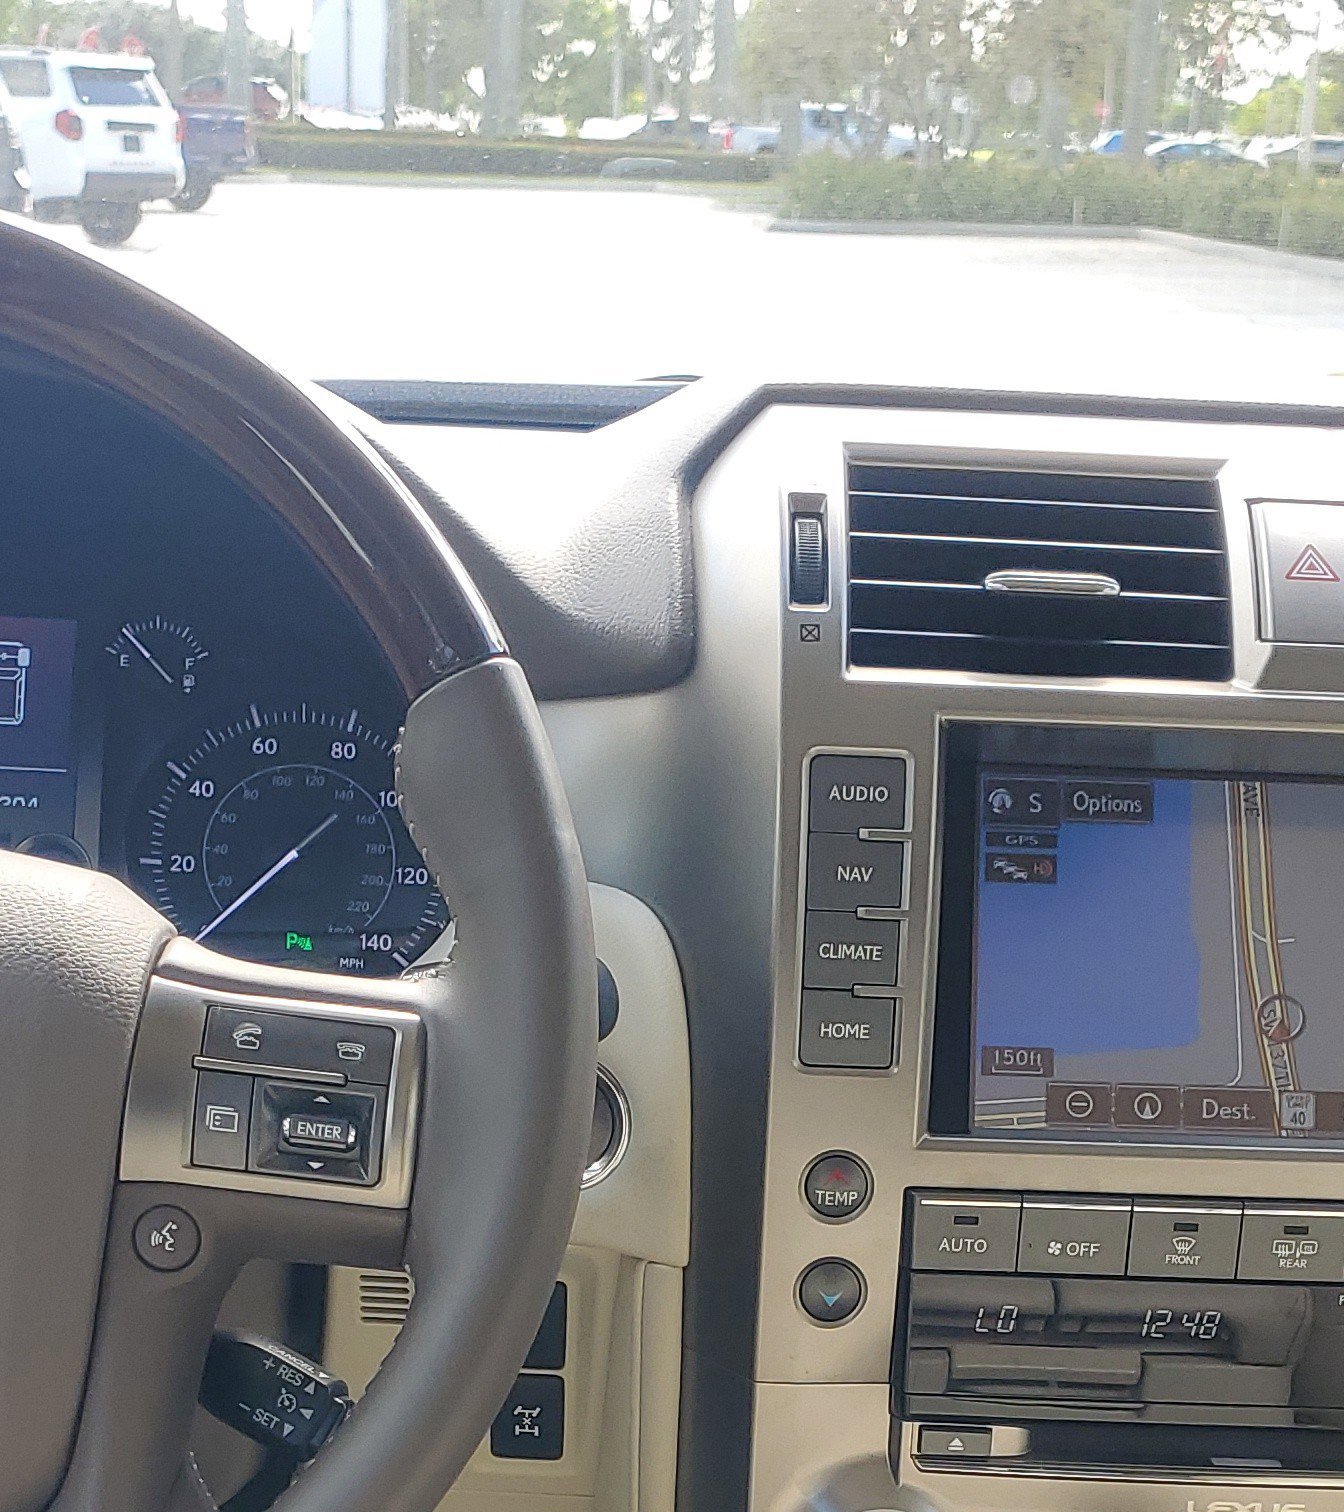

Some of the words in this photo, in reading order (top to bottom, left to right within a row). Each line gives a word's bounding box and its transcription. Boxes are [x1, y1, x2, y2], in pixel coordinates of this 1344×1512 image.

[120, 654, 130, 667] E
[185, 657, 196, 670] F
[252, 738, 278, 755] 60
[330, 742, 356, 760] 80
[188, 780, 214, 798] 40
[828, 784, 889, 803] AUDIO
[1029, 792, 1043, 814] S
[1072, 790, 1143, 817] Options
[1005, 835, 1039, 846] GPS
[169, 855, 195, 873] 20
[395, 867, 428, 885] 120
[837, 866, 874, 883] NAV
[359, 933, 393, 951] 140
[818, 943, 883, 961] CLIMATE
[339, 957, 365, 969] MPH
[819, 1021, 871, 1040] HOME
[992, 1049, 1043, 1067] 150ft
[1202, 1098, 1256, 1121] Dest.
[1290, 1111, 1306, 1125] 40
[296, 1123, 342, 1140] ENTER
[815, 1190, 858, 1207] TEMP
[938, 1237, 988, 1254] AUTO
[1066, 1242, 1100, 1258] OFF
[1164, 1254, 1201, 1266] FRONT
[1279, 1257, 1308, 1270] REAR
[268, 1345, 315, 1374] CANCEL
[276, 1364, 305, 1387] RES
[252, 1408, 281, 1430] SET
